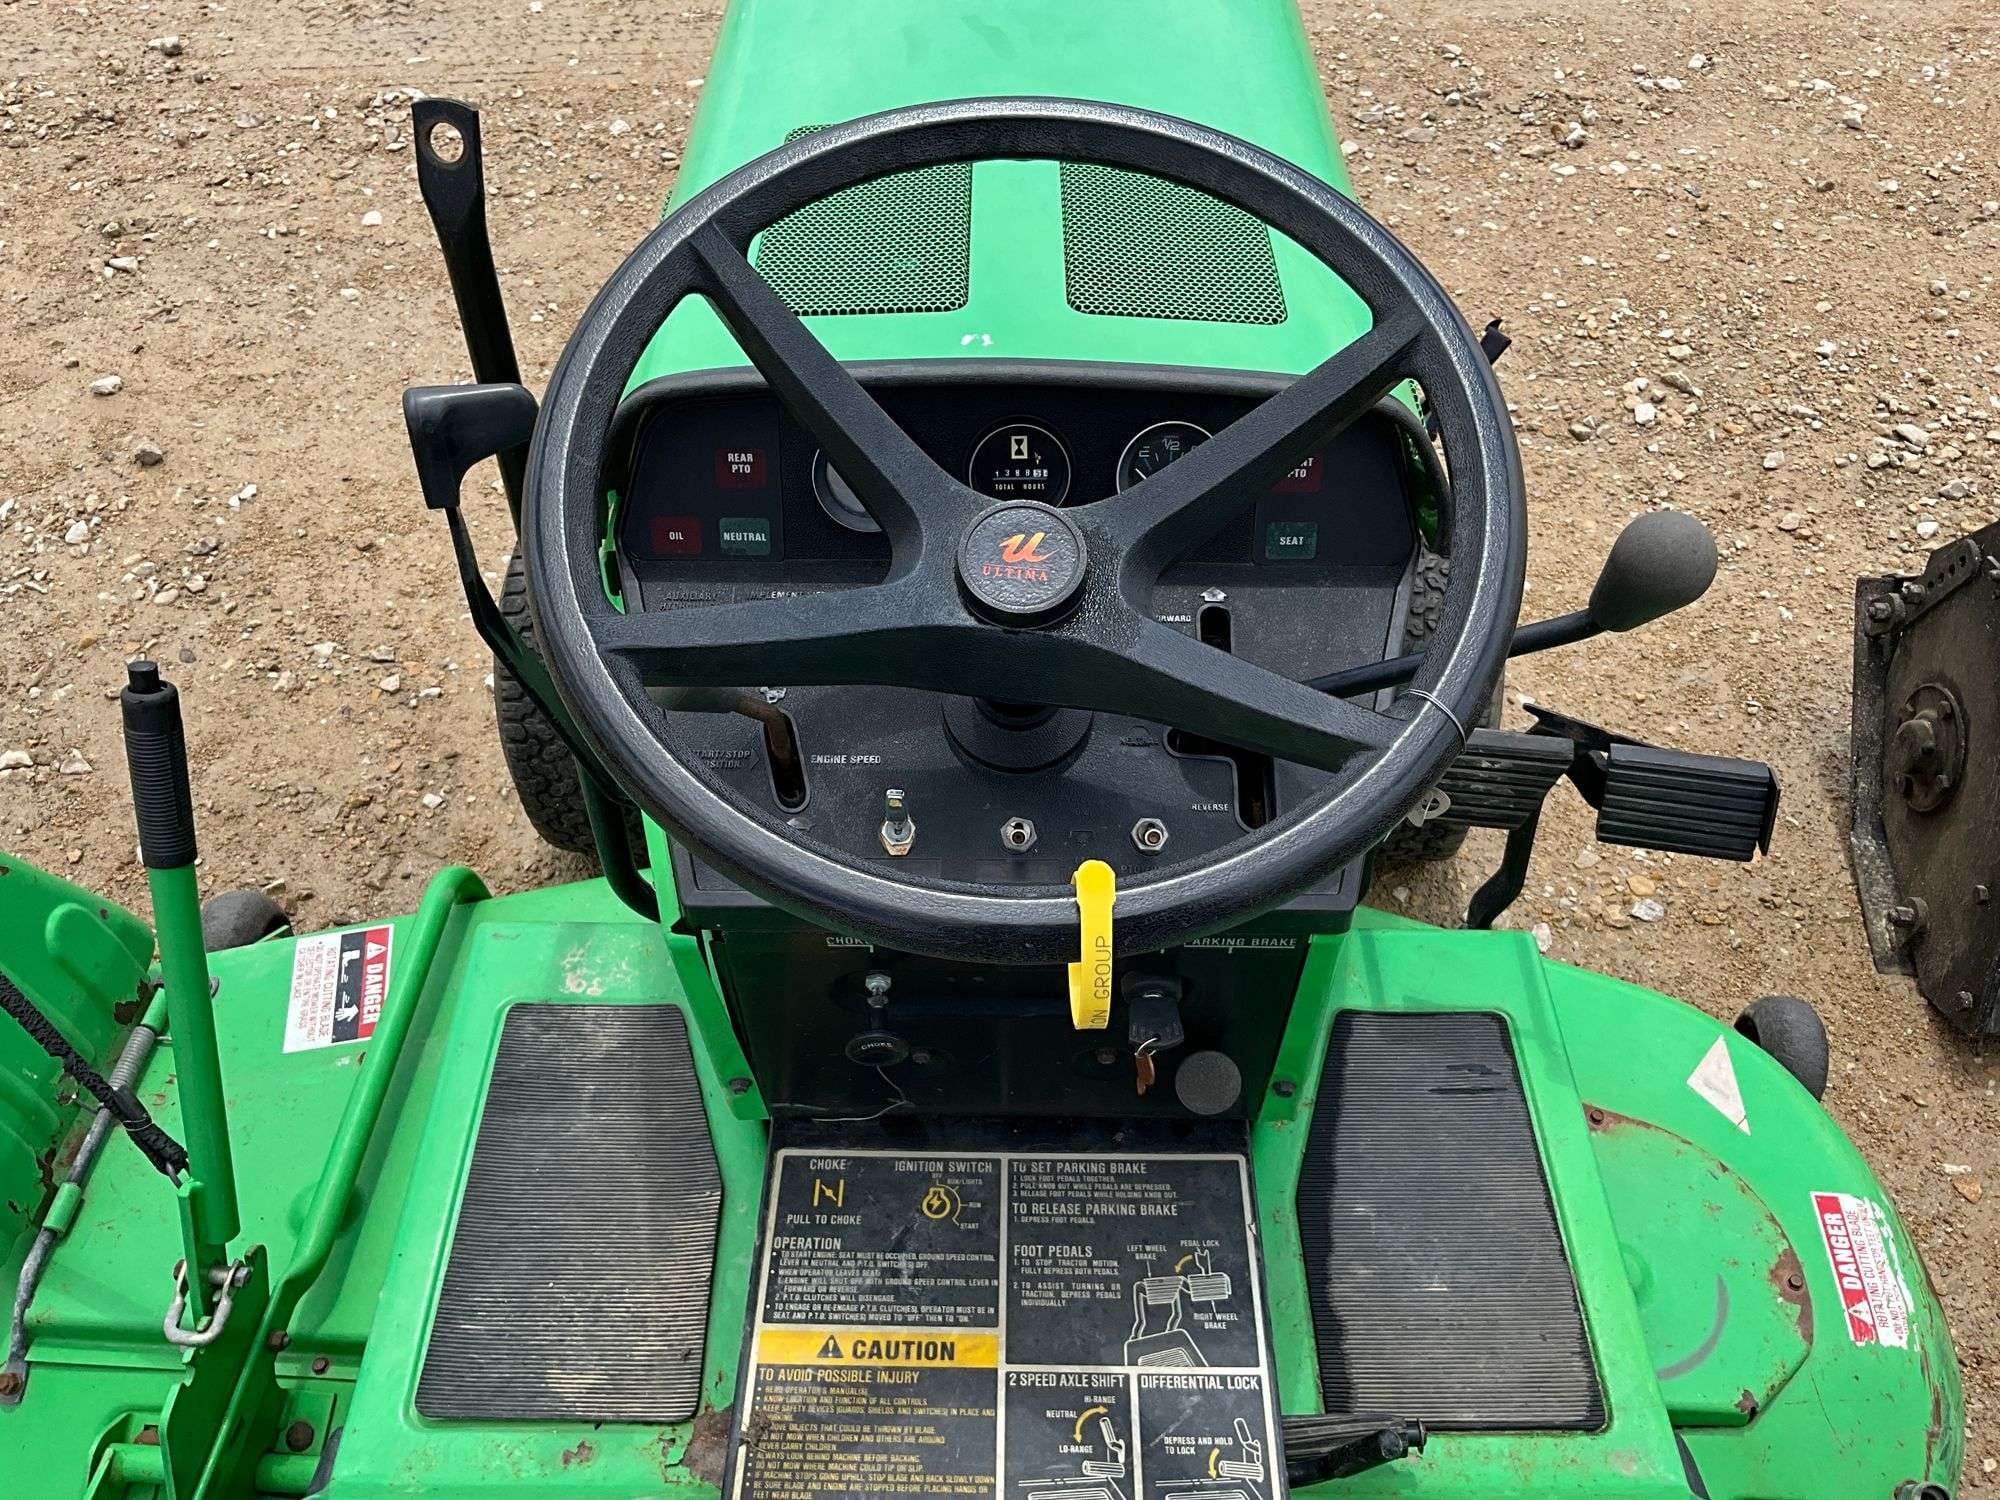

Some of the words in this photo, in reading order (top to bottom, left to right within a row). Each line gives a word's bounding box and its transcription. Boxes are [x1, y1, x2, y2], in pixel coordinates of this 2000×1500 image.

[728, 453, 753, 462] REAR
[732, 464, 751, 474] PTO
[668, 532, 684, 540] OIL
[723, 532, 767, 542] NEUTRAL
[1280, 536, 1304, 546] SEAT
[982, 564, 1049, 582] ULTIMA
[810, 754, 847, 764] ENGINE
[850, 755, 881, 764] SPEED
[826, 936, 867, 945] CHOK
[1192, 938, 1245, 946] ARKING
[1251, 938, 1297, 946] BRAKE
[1094, 936, 1112, 1000] GROUP
[362, 963, 384, 1024] DANGER
[861, 1042, 892, 1050] CHOKE
[809, 1158, 847, 1170] CHOKE
[894, 1160, 944, 1172] IGNITION
[948, 1161, 992, 1172] SWITCH
[1012, 1162, 1026, 1173] TO
[1030, 1162, 1052, 1173] SET
[1056, 1162, 1106, 1174] PARKING
[1110, 1163, 1148, 1174] BRAKE
[1012, 1203, 1027, 1214] TO
[1031, 1203, 1081, 1215] RELEASE
[1085, 1204, 1136, 1215] PARKING
[1140, 1204, 1178, 1216] BRAKE
[786, 1214, 811, 1224] PULL
[815, 1215, 828, 1224] TO
[830, 1215, 862, 1225] CHOKE
[1846, 1210, 1864, 1236] BLADE
[960, 1222, 979, 1230] START
[773, 1236, 842, 1250] OPERATION
[1014, 1244, 1044, 1257] FOOT
[1048, 1245, 1093, 1258] PEDALS
[1824, 1213, 1864, 1290] DANGER
[1058, 1259, 1088, 1267] TRACTOR
[1854, 1239, 1876, 1279] CUTTING
[1021, 1267, 1041, 1275] FULLY
[1044, 1267, 1072, 1275] DEPRESS
[1096, 1291, 1121, 1299] PEDALS
[1867, 1283, 1889, 1328] ROTATING
[792, 1312, 806, 1320] AND
[926, 1314, 942, 1322] THEN
[852, 1339, 955, 1361] CAUTION
[760, 1367, 774, 1381] TO
[778, 1368, 812, 1381] AVOID
[818, 1369, 872, 1382] POSSIBLE
[877, 1370, 920, 1383] INJURY
[1010, 1373, 1016, 1386] 2
[1020, 1373, 1056, 1387] SPEED
[1060, 1374, 1088, 1387] AXLE
[1092, 1374, 1125, 1387] SHIFT
[1141, 1375, 1224, 1389] DIFFERENTIAL
[1227, 1376, 1259, 1390] LOCK
[1046, 1410, 1078, 1418] NEUTRAL
[1164, 1436, 1195, 1444] DEPRESS
[1198, 1436, 1212, 1445] AND
[1214, 1437, 1233, 1445] HOLD
[1059, 1445, 1093, 1453] LO-RANGE
[1166, 1446, 1175, 1454] TO
[1177, 1446, 1196, 1454] LOCK
